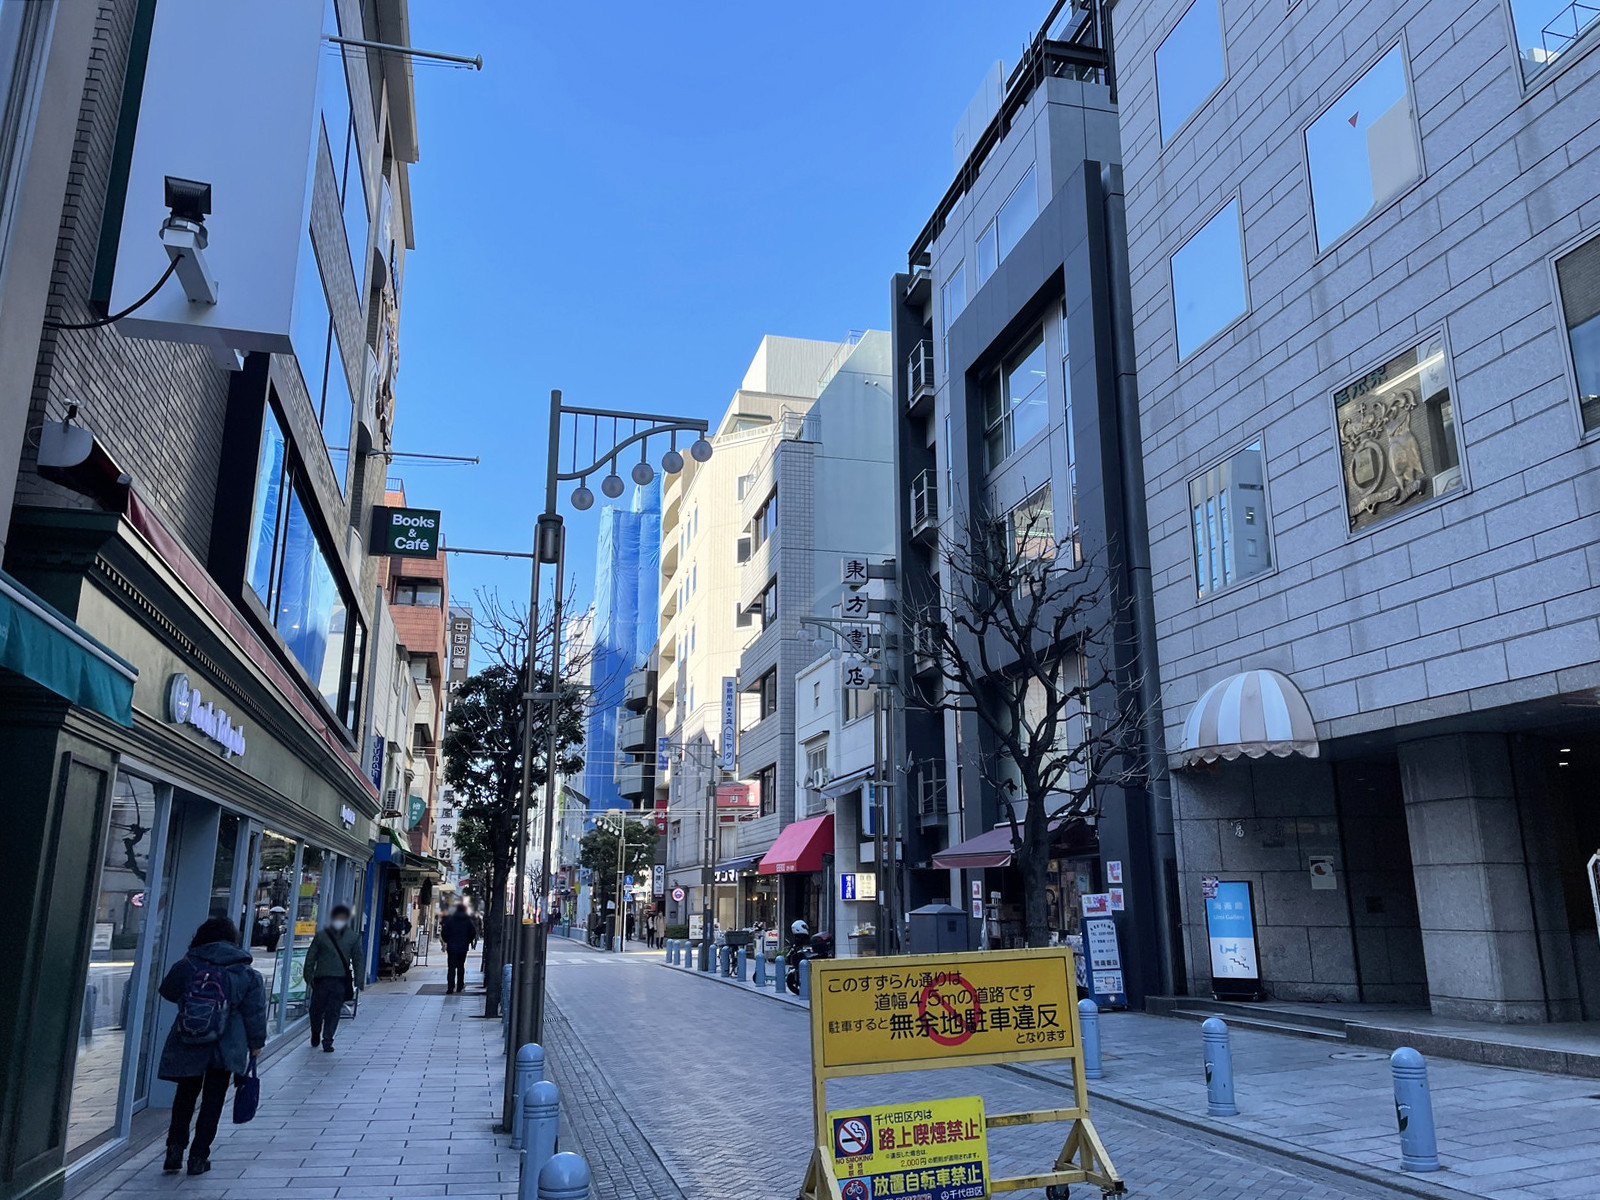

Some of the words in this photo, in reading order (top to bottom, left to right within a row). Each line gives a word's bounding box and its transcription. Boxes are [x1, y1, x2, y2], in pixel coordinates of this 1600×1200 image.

[392, 514, 435, 528] Books
[407, 528, 417, 538] &
[845, 560, 866, 686] 東方書店
[1222, 965, 1234, 973] B1
[827, 970, 962, 993] このすずらん通りは
[874, 984, 1036, 1011] 道幅4.5mの道路です
[828, 1017, 888, 1034] 駐車すると
[889, 1003, 1060, 1040] 無余地駐車違反
[1015, 1030, 1067, 1044] となります
[874, 1109, 933, 1126] 千代田区内は
[878, 1117, 981, 1151] 路上喫煙禁止
[836, 1157, 845, 1165] NO
[845, 1155, 874, 1164] SMOKING
[873, 1164, 982, 1197] 放置自転車禁止
[949, 1186, 983, 1198] 千代田区
